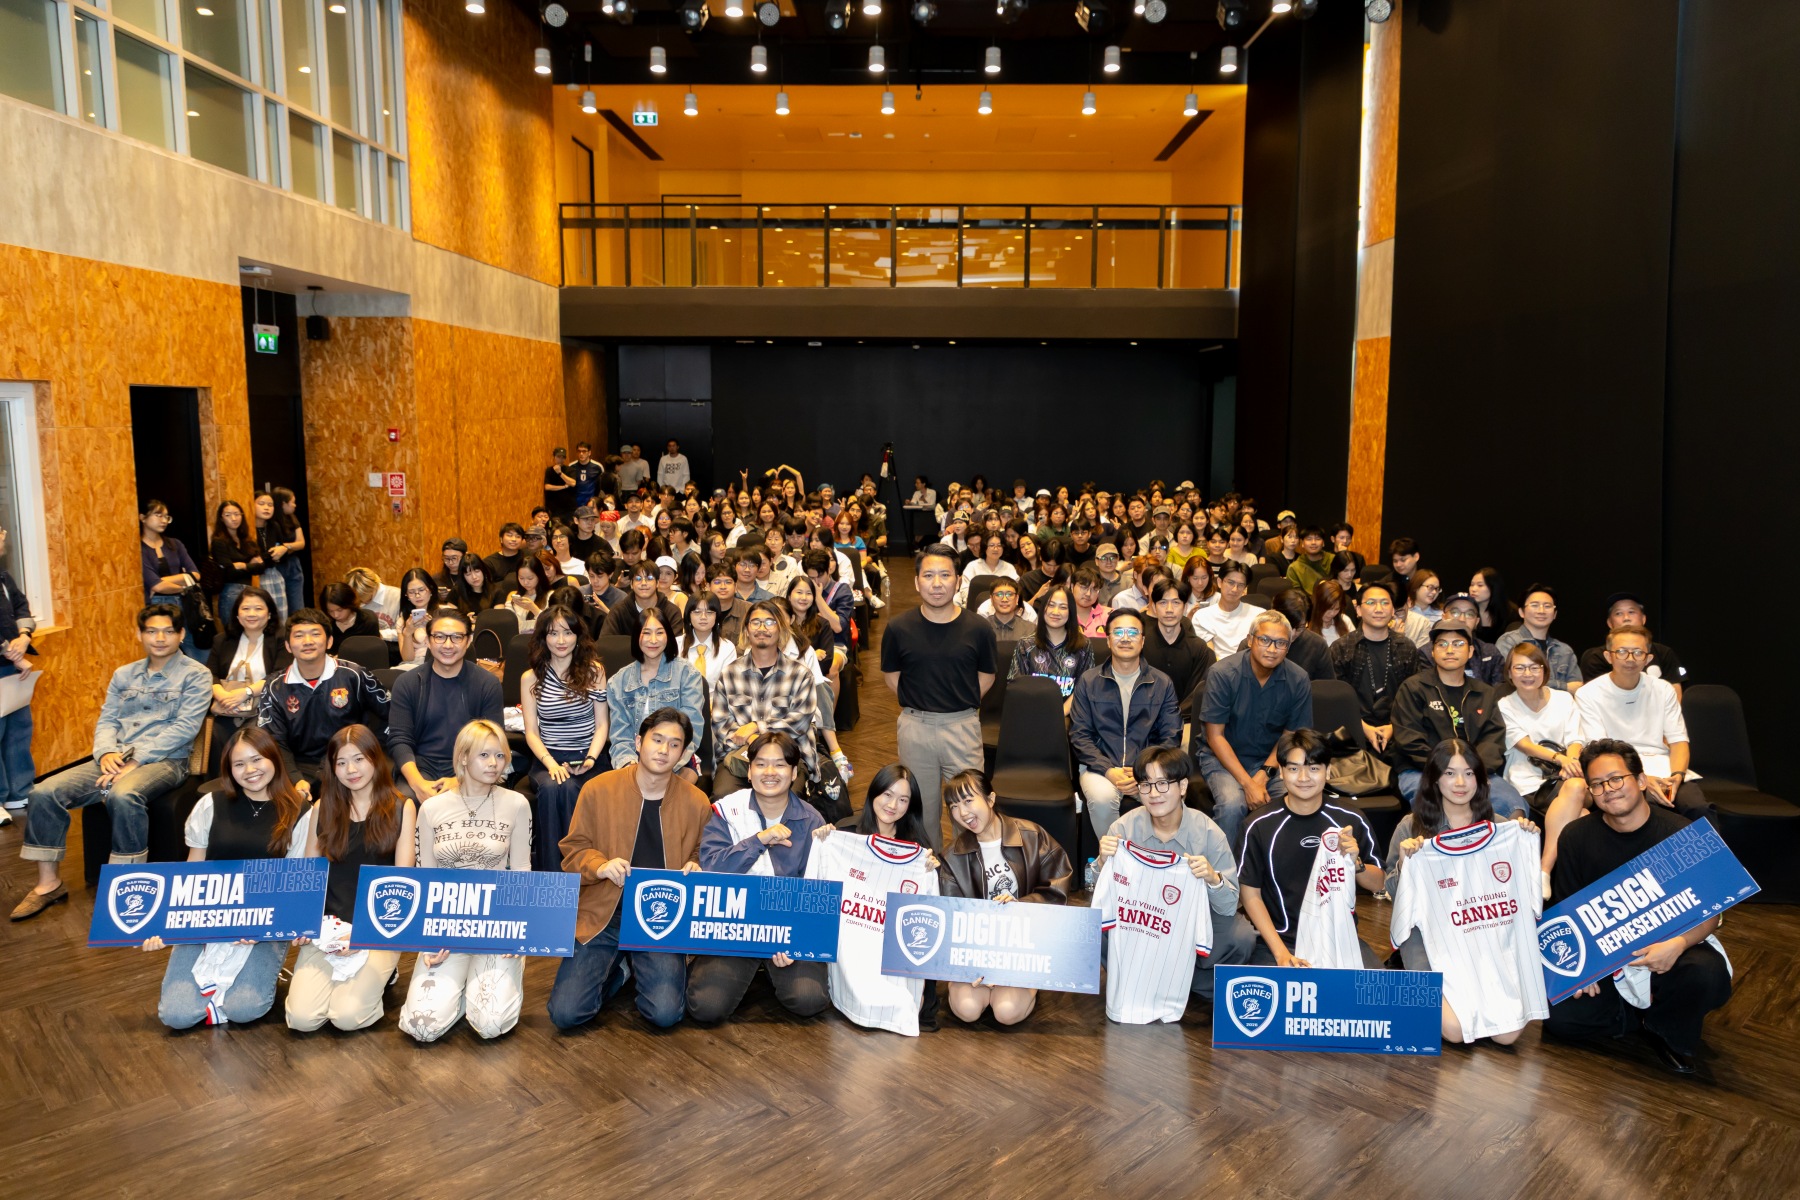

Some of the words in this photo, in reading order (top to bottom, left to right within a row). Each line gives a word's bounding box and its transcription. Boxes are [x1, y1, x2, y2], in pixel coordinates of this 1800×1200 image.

[434, 822, 456, 834] MY
[461, 820, 509, 830] HURT
[434, 832, 462, 844] WILL
[490, 834, 507, 843] ON
[243, 859, 284, 874] FIGHT
[288, 858, 316, 872] FOR
[984, 864, 1002, 880] RIC
[1004, 862, 1010, 872] S
[117, 884, 158, 896] CANNES
[168, 873, 244, 907] MEDIA
[244, 872, 276, 894] THAI
[496, 871, 534, 886] FIGHT
[540, 872, 567, 888] FOR
[376, 888, 414, 900] CANNES
[426, 882, 496, 916] PRINT
[496, 885, 528, 906] THAI
[642, 892, 680, 903] CANNES
[692, 885, 748, 920] FILM
[760, 890, 792, 912] THAI
[876, 898, 886, 907] YO
[1478, 891, 1507, 902] YOUNG
[1576, 868, 1666, 936] DESIGN
[164, 908, 275, 929] REPRESENTATIVE
[842, 899, 886, 925] CANN
[1139, 900, 1166, 916] YOUNG
[1450, 898, 1518, 926] CANNES
[422, 918, 528, 940] REPRESENTATIVE
[902, 916, 940, 928] CANNES
[952, 912, 1036, 949] DIGITAL
[1118, 906, 1172, 934] ANNES
[1464, 922, 1499, 934] COMPETITION
[1596, 887, 1701, 956] REPRESENTATIVE
[690, 921, 792, 944] REPRESENTATIVE
[1540, 928, 1572, 950] CANNES
[950, 948, 1052, 974] REPRESENTATIVE
[1354, 970, 1396, 985] FIGHT
[1400, 971, 1428, 986] FOR
[1233, 988, 1272, 1000] CANNES
[1286, 981, 1318, 1014] PR
[1354, 984, 1390, 1006] THAI
[1284, 1018, 1392, 1038] REPRESENTATIVE
